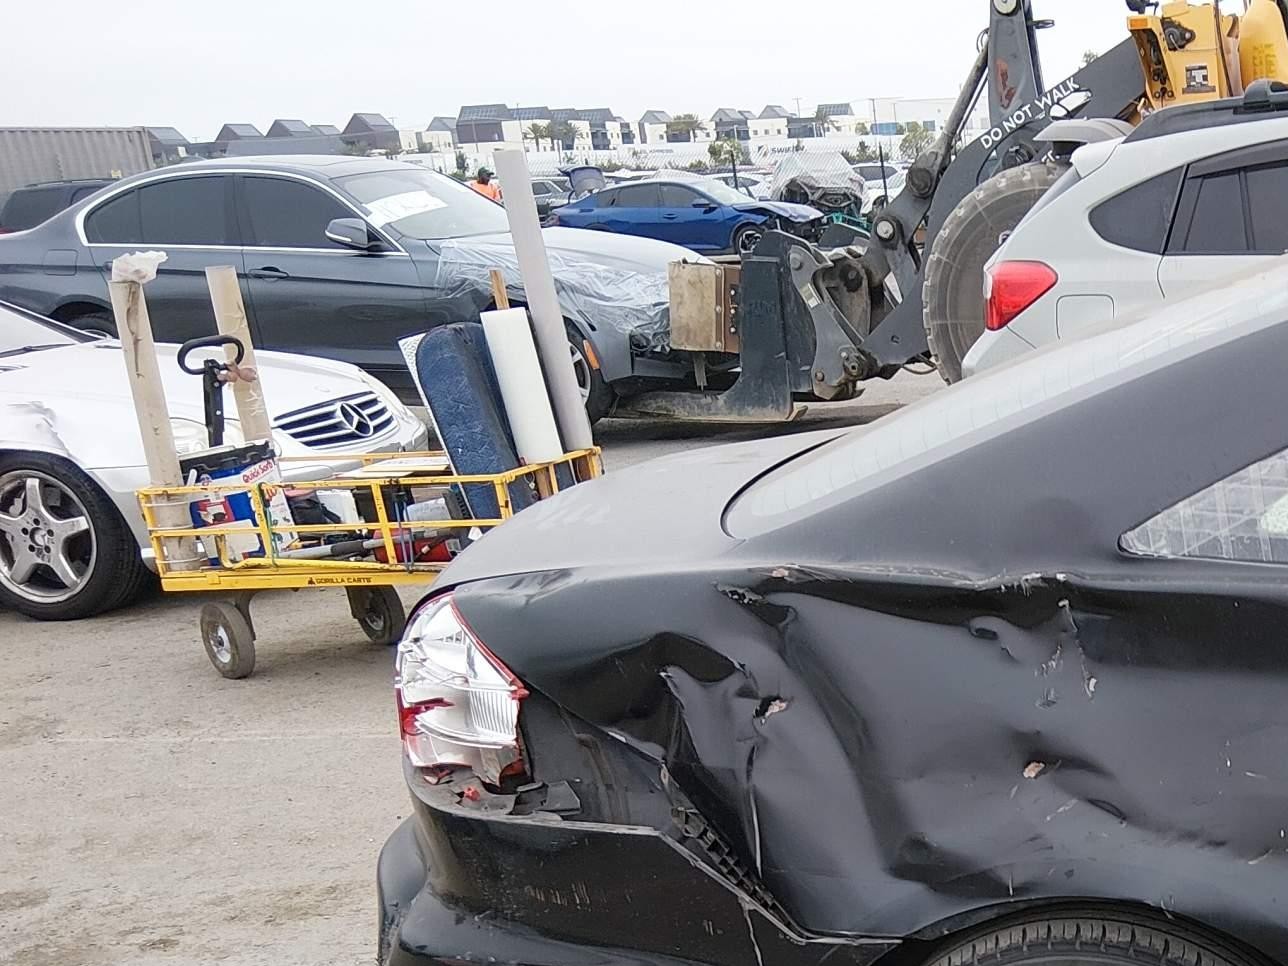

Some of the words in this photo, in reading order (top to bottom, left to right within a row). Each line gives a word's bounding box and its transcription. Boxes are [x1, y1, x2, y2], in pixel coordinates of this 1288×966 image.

[980, 127, 1002, 149] DO
[1002, 104, 1032, 133] NOT
[1034, 77, 1080, 110] WALK
